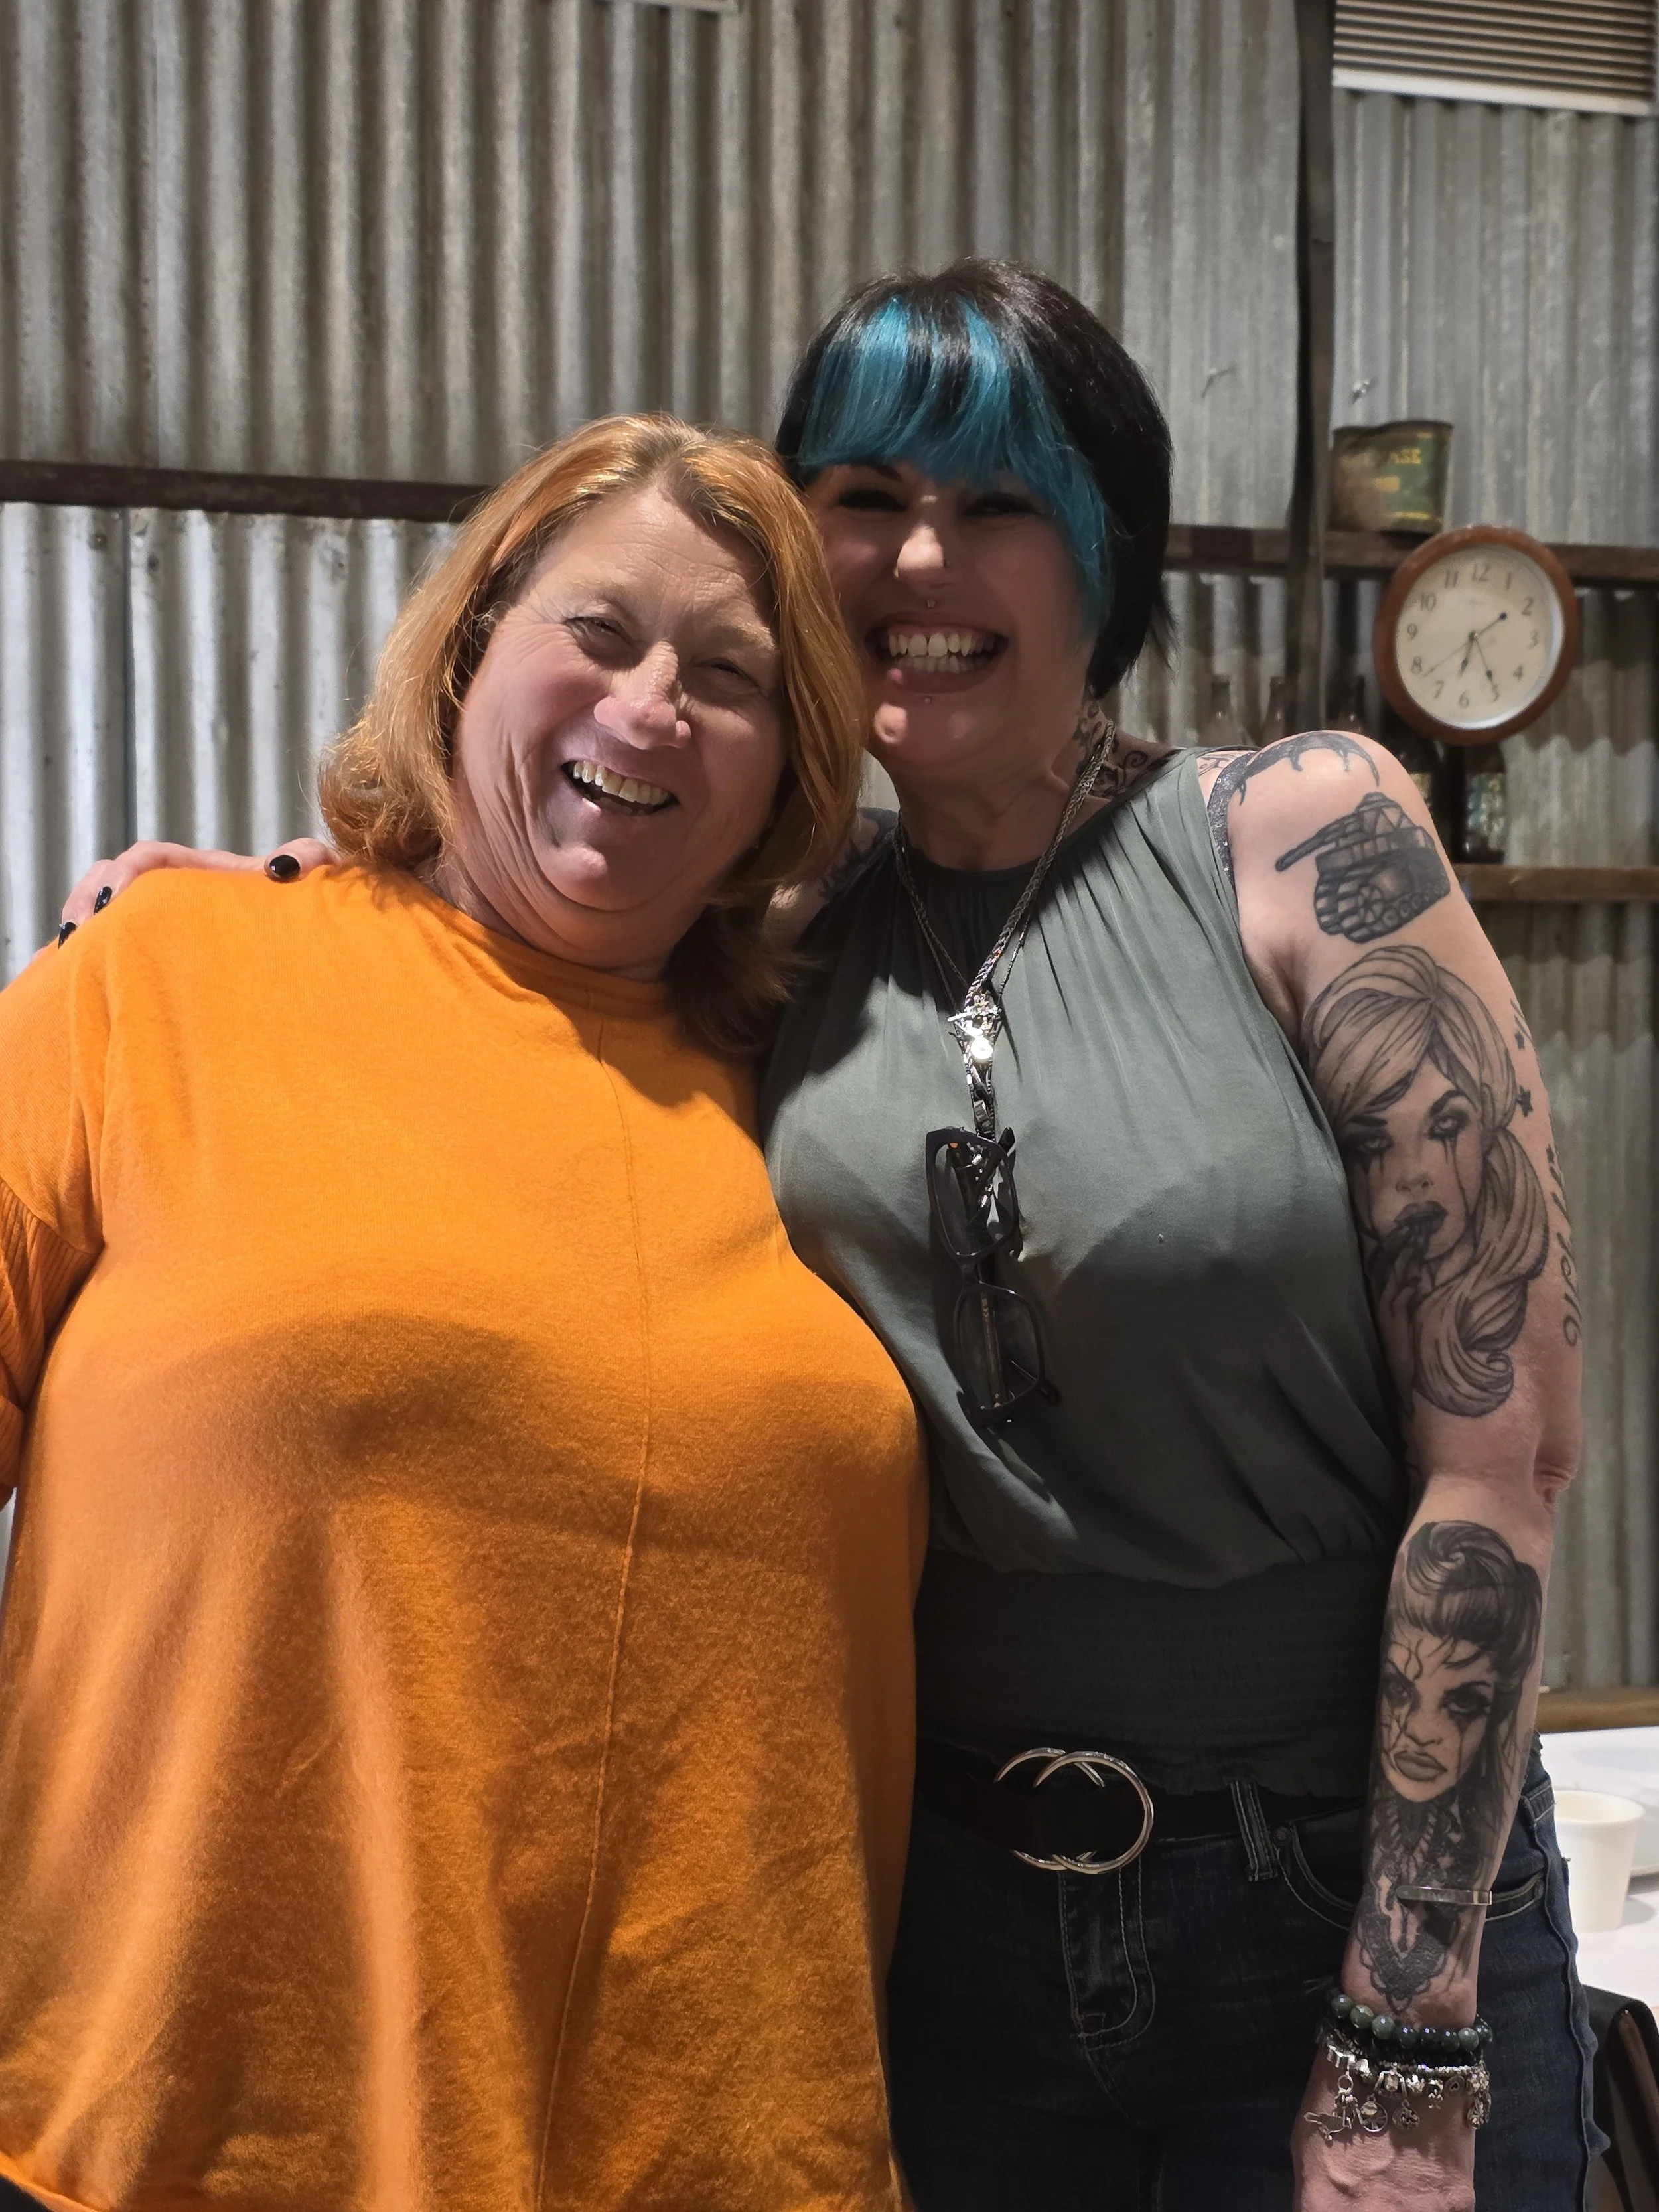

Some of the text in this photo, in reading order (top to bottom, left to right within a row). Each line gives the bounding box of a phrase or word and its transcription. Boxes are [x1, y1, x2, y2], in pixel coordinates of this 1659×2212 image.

[1444, 570, 1459, 588] 11
[1472, 563, 1490, 583] 12
[1504, 571, 1512, 591] 1
[1419, 591, 1437, 611] 10
[1522, 597, 1534, 615] 2
[1406, 624, 1418, 639] 9
[1528, 630, 1539, 648] 3
[1411, 656, 1423, 674] 8
[1513, 666, 1524, 680] 4
[1434, 680, 1445, 698] 7
[1459, 690, 1470, 709] 6
